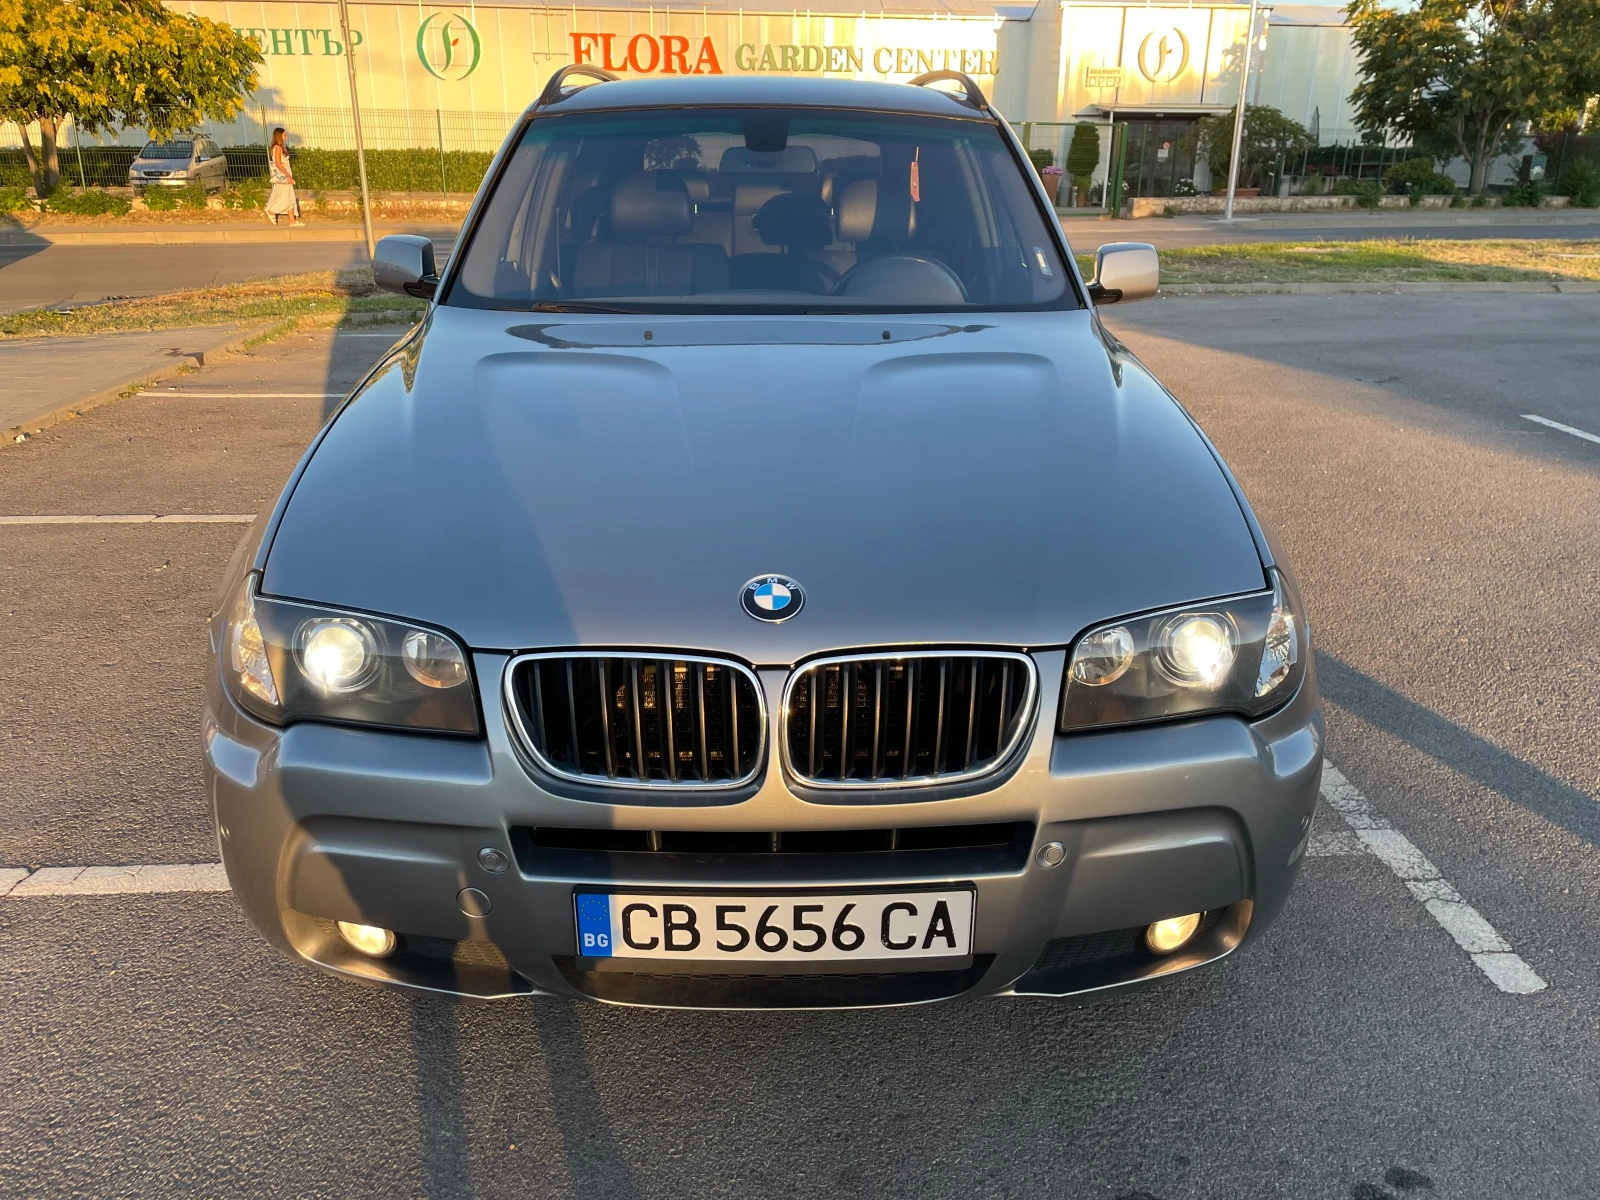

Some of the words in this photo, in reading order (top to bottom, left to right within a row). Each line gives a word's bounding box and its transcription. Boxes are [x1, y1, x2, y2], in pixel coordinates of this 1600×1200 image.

[569, 32, 723, 75] FLORA
[735, 42, 864, 73] GARDEN
[873, 47, 1000, 75] CENTER
[1088, 76, 1121, 87] OPEN
[749, 577, 798, 591] BMW
[621, 902, 701, 952] CB
[715, 902, 866, 953] 5656
[881, 900, 957, 951] CA
[583, 932, 609, 948] BG
